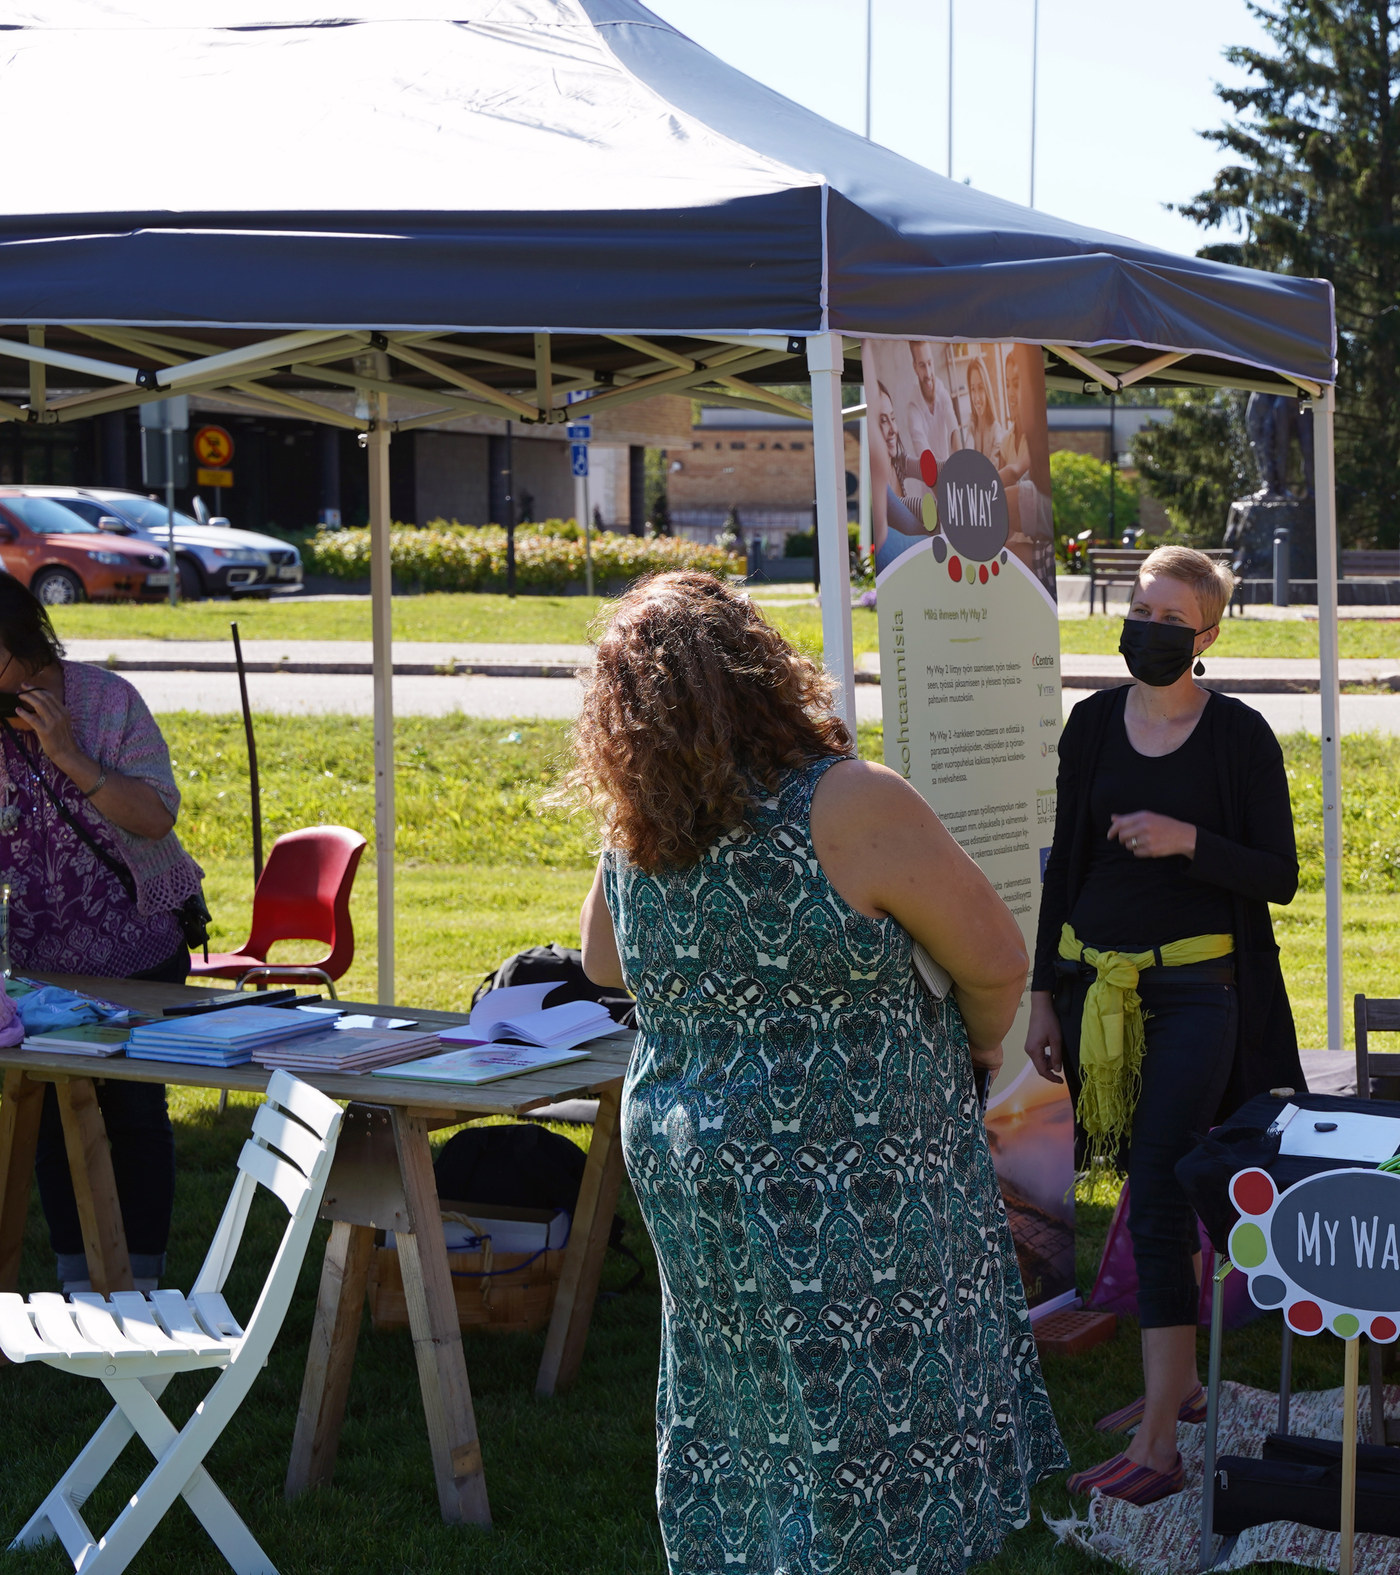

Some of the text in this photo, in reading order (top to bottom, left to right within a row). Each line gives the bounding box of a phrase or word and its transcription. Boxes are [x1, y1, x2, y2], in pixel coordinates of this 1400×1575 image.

[947, 482, 963, 526] MY
[939, 608, 959, 620] ihmeen
[960, 607, 968, 622] My
[969, 607, 980, 622] Way
[1035, 655, 1054, 666] Centria
[926, 665, 934, 677] My
[935, 665, 944, 676] Way
[945, 664, 949, 674] 2
[893, 610, 911, 779] kohtaamisia
[930, 731, 937, 743] My
[937, 731, 948, 742] Way
[948, 730, 952, 739] 2
[1298, 1212, 1339, 1266] MY
